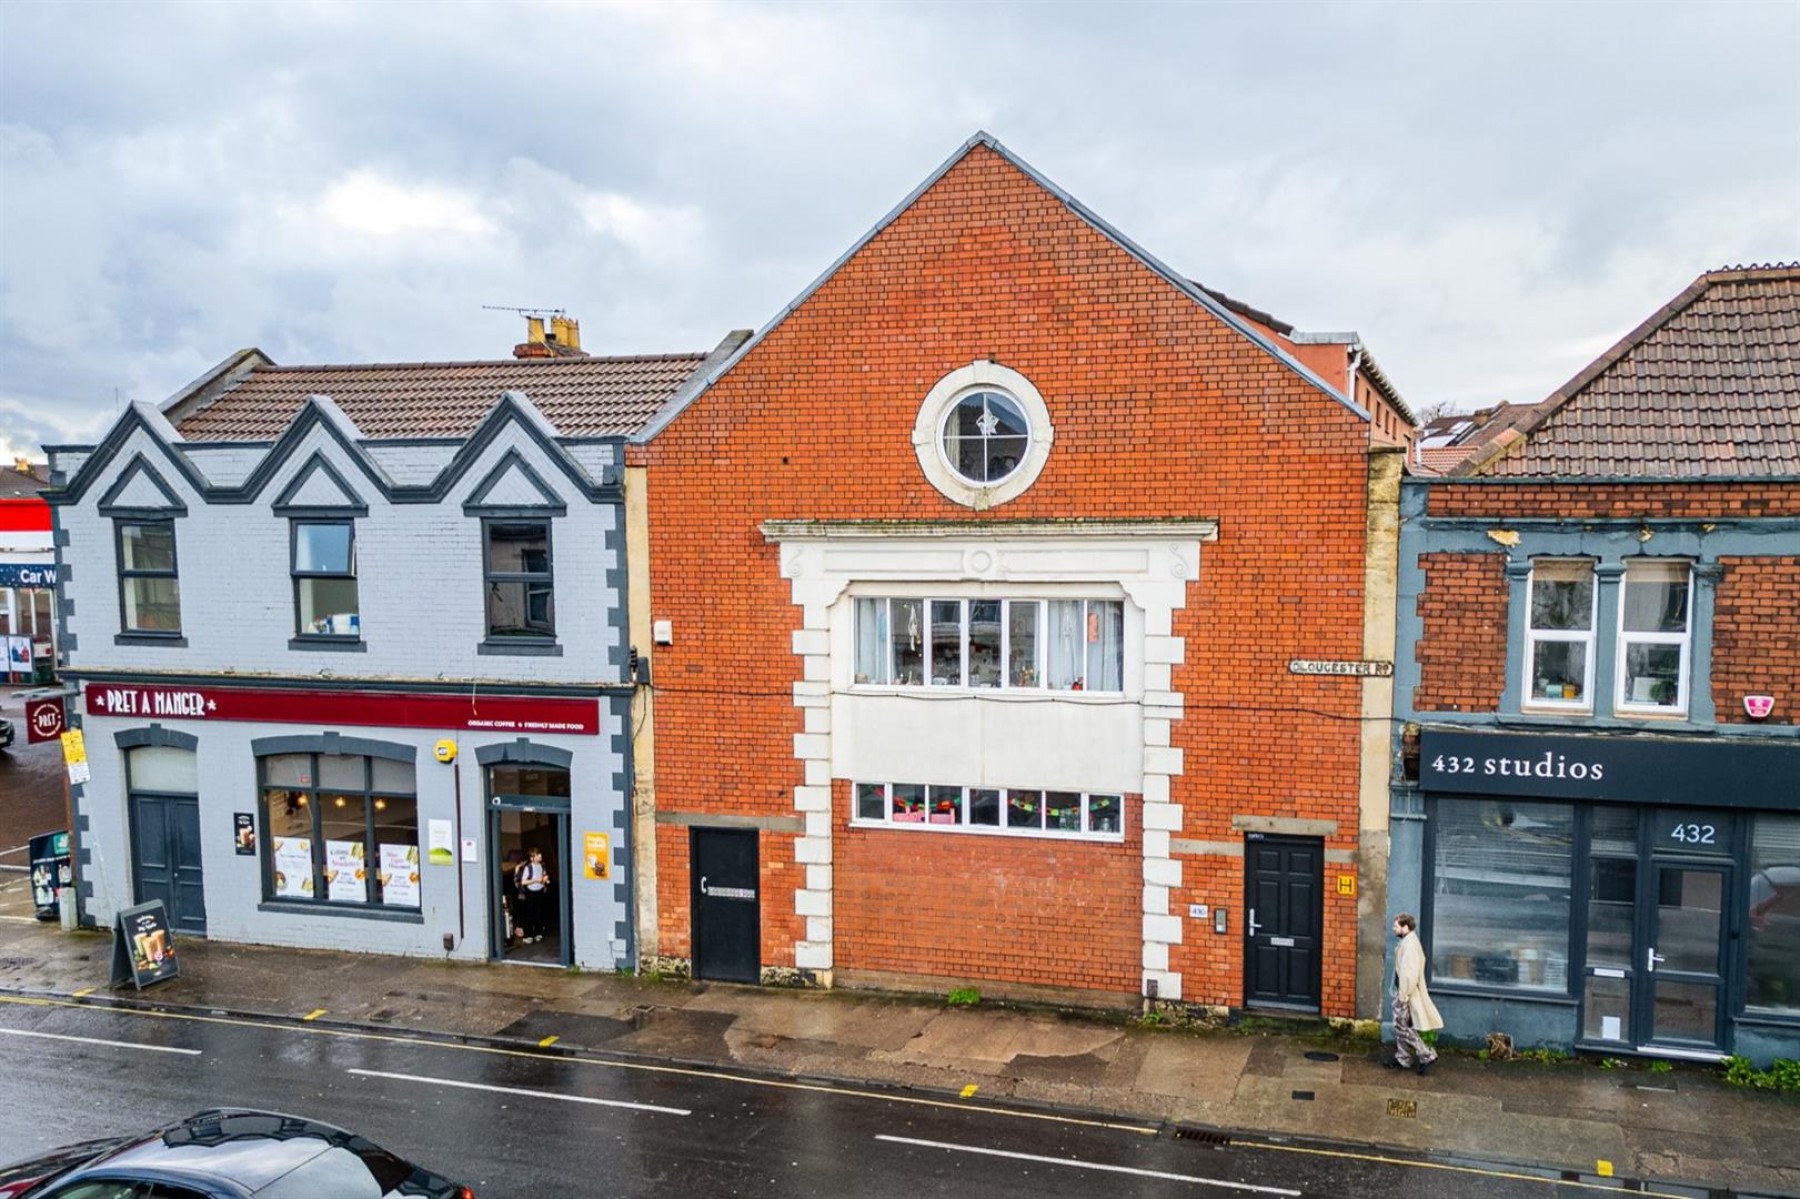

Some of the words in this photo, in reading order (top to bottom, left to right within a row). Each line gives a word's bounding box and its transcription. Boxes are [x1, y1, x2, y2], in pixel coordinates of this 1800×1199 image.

[20, 568, 42, 583] Car
[1293, 662, 1370, 674] GLOUCESTER
[107, 689, 138, 713] PRET
[141, 691, 151, 714] A
[155, 691, 205, 716] MANGER
[38, 713, 56, 728] PRET
[1432, 755, 1476, 774] 432
[1484, 751, 1604, 780] studios
[1670, 823, 1715, 844] 432
[1339, 877, 1352, 893] H
